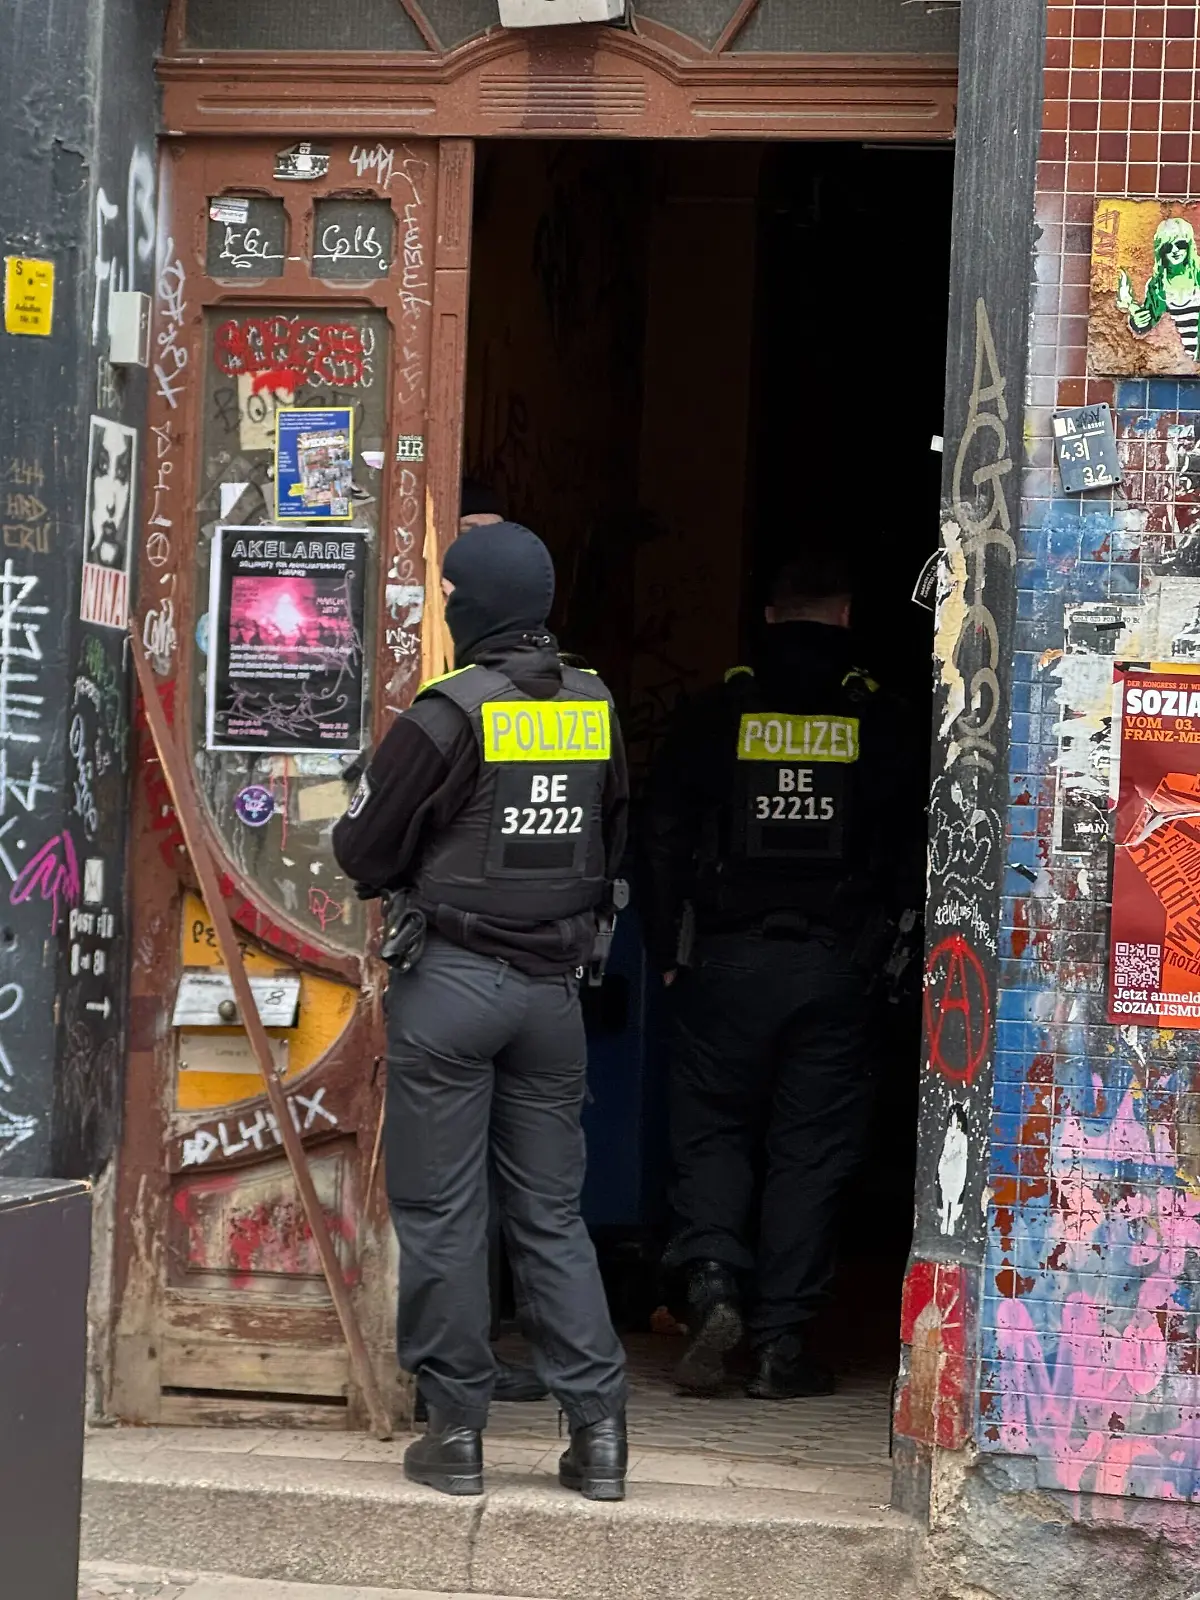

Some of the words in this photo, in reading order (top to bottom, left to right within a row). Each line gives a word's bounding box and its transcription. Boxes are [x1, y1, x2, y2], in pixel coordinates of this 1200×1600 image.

[15, 260, 23, 275] S
[396, 440, 424, 456] HR
[231, 540, 356, 560] AKELARRE
[1142, 681, 1177, 689] KONGRESS
[492, 709, 606, 752] POLIZEI
[1125, 716, 1163, 729] VOM
[1175, 718, 1196, 731] 03.
[743, 719, 856, 758] POLIZEI
[1124, 728, 1200, 744] FRANZ-ME
[530, 774, 568, 802] BE
[778, 768, 813, 793] BE
[755, 796, 835, 820] 32215
[501, 806, 583, 835] 32222
[1114, 988, 1148, 1001] Jetzt
[1151, 991, 1200, 1003] anmeld
